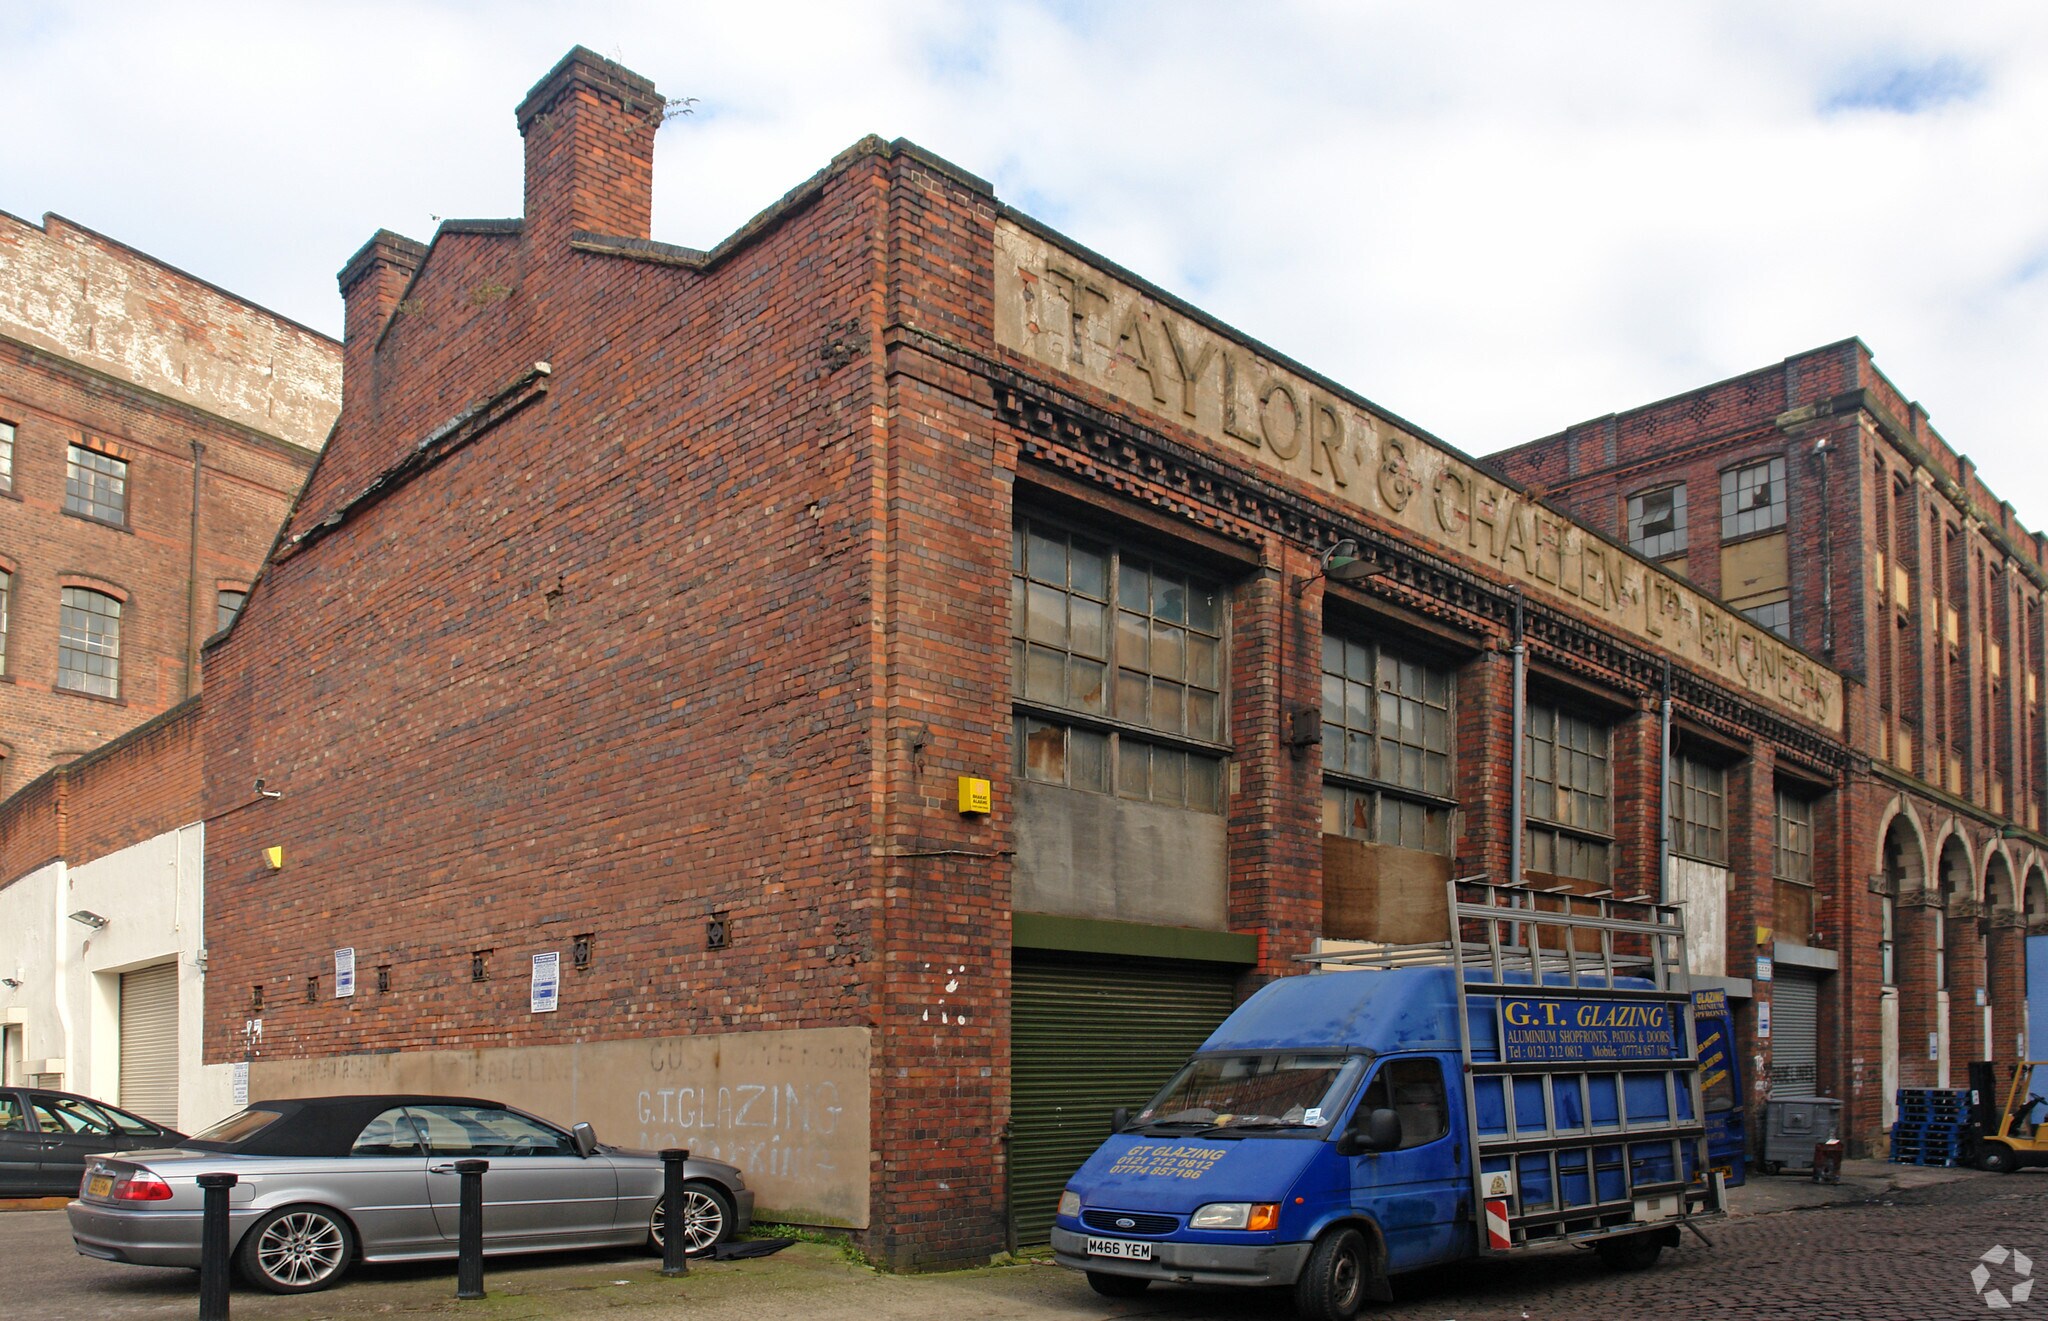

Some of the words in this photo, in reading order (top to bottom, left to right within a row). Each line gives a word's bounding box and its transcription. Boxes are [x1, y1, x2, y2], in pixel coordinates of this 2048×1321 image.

[1047, 257, 1347, 488] TAYLOR
[1378, 438, 1418, 513] &
[1434, 466, 1624, 612] CHALLEN
[1696, 991, 1725, 1004] GLAZING
[1505, 1001, 1567, 1026] G.T.
[1577, 1004, 1664, 1027] GLAZING
[1508, 1030, 1557, 1043] ALUMINIUM
[1612, 1031, 1636, 1043] PATIOS
[1639, 1031, 1645, 1043] &
[1647, 1031, 1670, 1043] DOORS
[1527, 1045, 1546, 1058] 0121
[1550, 1045, 1563, 1058] 212
[1565, 1045, 1583, 1058] 0812
[1128, 1146, 1153, 1156] GT
[1151, 1146, 1226, 1160] GLAZING
[1116, 1156, 1148, 1165] 0121
[1149, 1157, 1173, 1167] 212
[1177, 1159, 1214, 1170] 0812
[1109, 1165, 1149, 1175] 07774
[1150, 1166, 1202, 1180] 857186
[1089, 1240, 1120, 1254] M466
[1125, 1242, 1150, 1257] YEM
